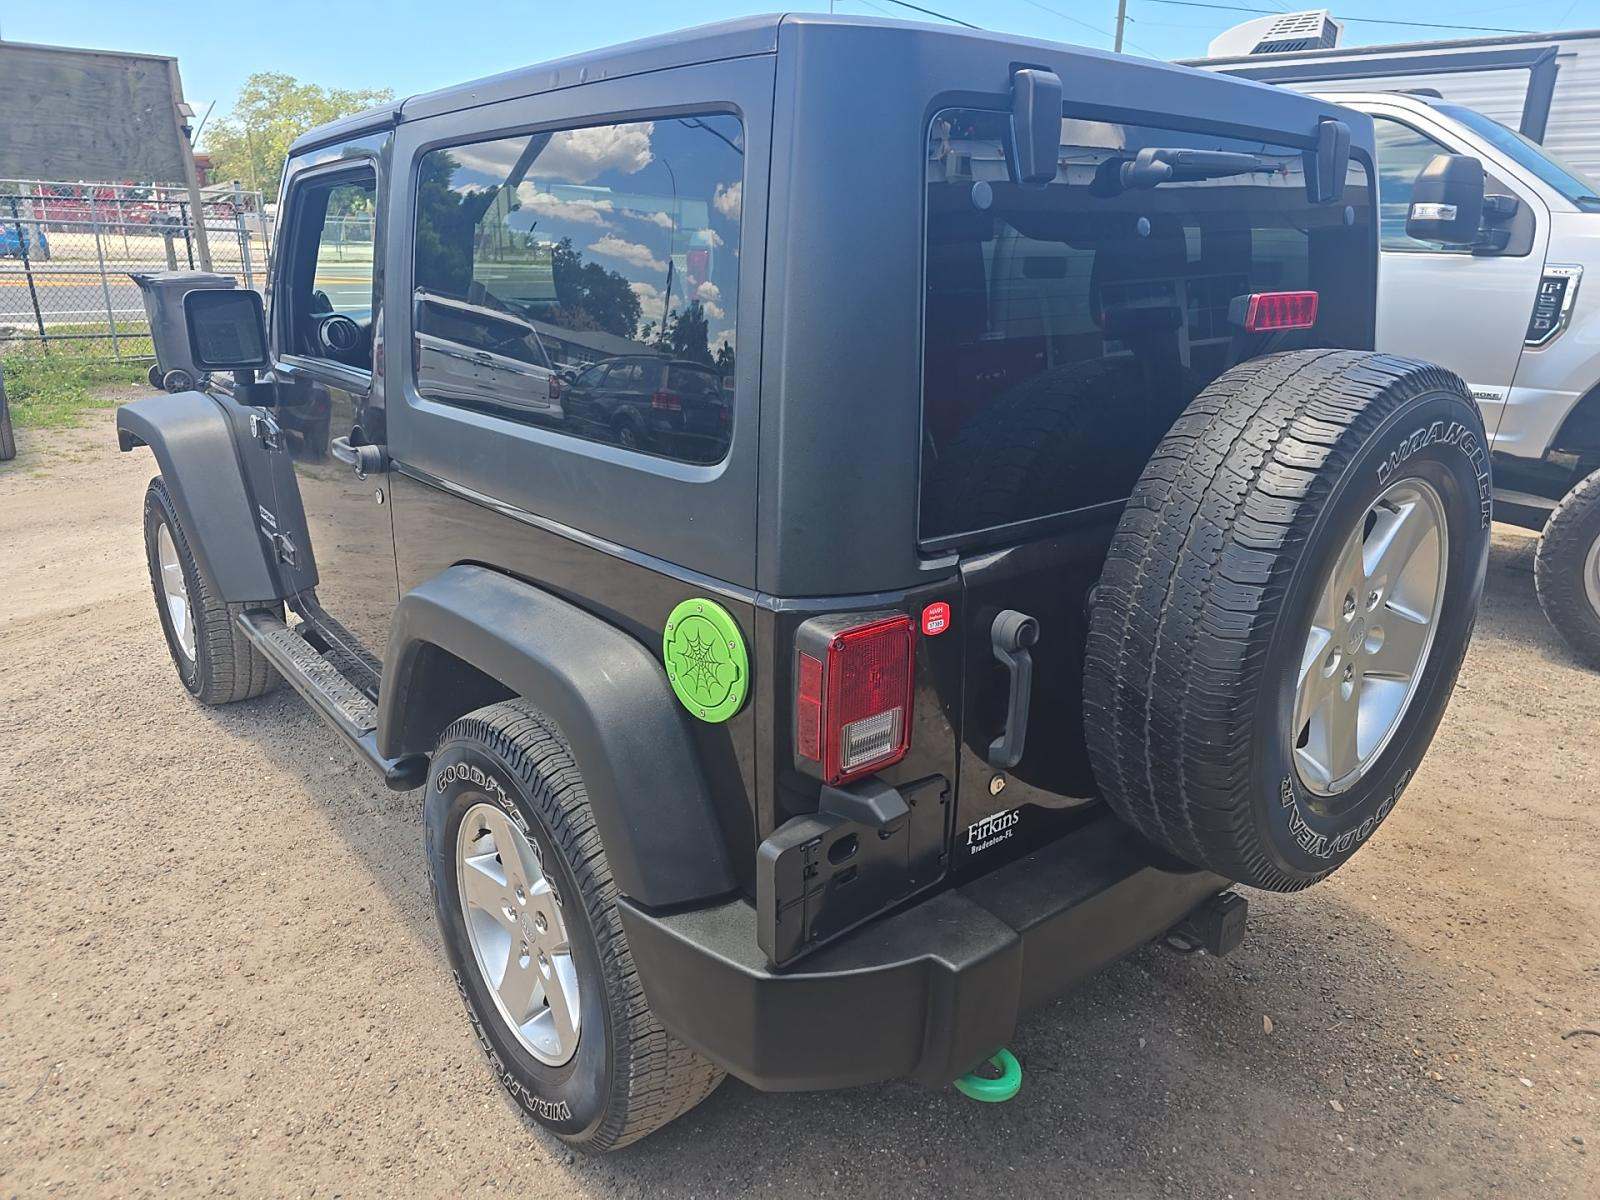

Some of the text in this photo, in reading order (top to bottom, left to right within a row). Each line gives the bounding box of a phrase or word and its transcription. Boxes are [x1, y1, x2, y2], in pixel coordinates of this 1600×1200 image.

[1376, 421, 1491, 529] WRANGLER
[436, 763, 564, 907] GOODYEAR
[966, 809, 1020, 846] Firkins
[1281, 769, 1412, 858] GOODYEAR
